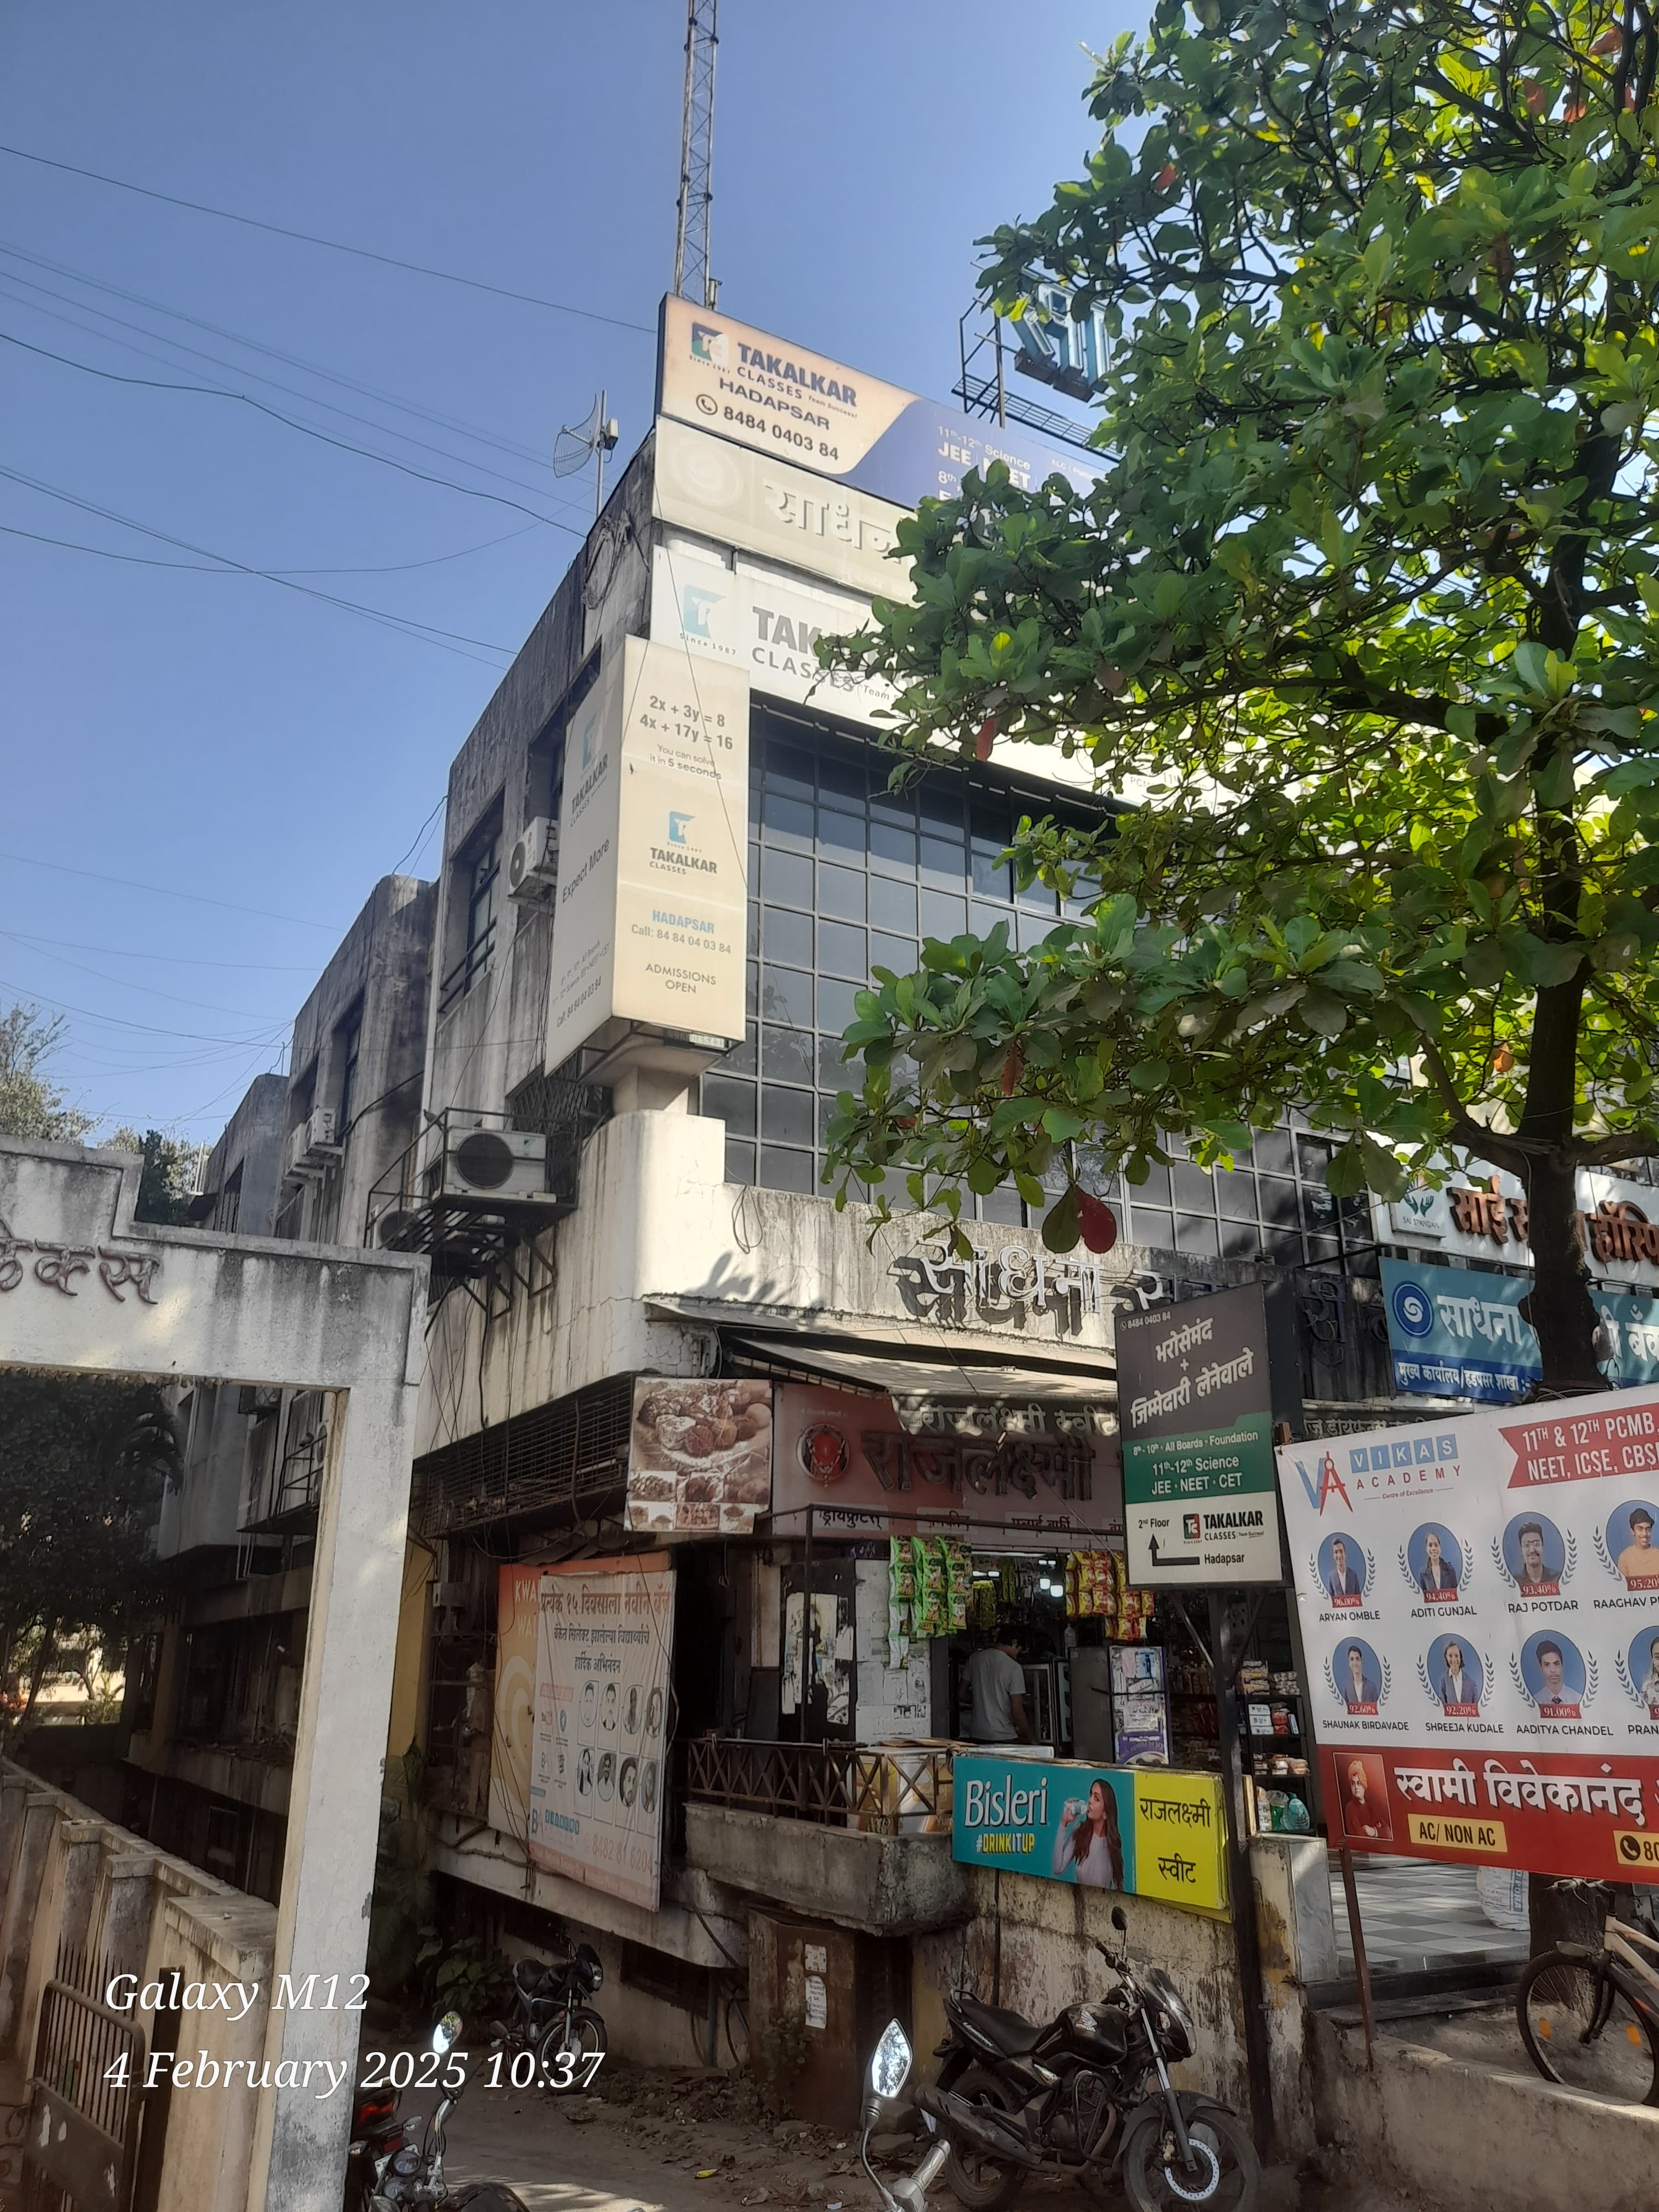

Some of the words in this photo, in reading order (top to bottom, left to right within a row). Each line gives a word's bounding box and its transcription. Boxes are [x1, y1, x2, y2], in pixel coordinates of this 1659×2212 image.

[737, 367, 802, 399] CLASSES
[738, 342, 857, 407] TAKALKAR
[720, 378, 830, 430] HADAPSAR
[724, 406, 766, 433] 8484
[772, 424, 813, 451] 0403
[818, 442, 839, 461] 84
[938, 442, 972, 466] JEE
[984, 444, 1031, 470] Science
[680, 633, 708, 648] Since
[712, 643, 737, 656] 1987
[863, 685, 890, 701] Team
[649, 695, 666, 712] 2x
[671, 706, 679, 714] +
[684, 705, 700, 722] 3y
[705, 714, 712, 722] =
[717, 714, 726, 728] 8
[640, 713, 657, 730] 4x
[661, 724, 670, 732] +
[675, 723, 700, 743] 17y
[703, 735, 712, 743] =
[716, 734, 733, 750] 16
[658, 743, 673, 757] You
[675, 750, 691, 761] can
[693, 753, 716, 767] solve
[650, 754, 656, 764] it
[658, 756, 666, 766] in
[667, 757, 675, 768] 5
[677, 761, 722, 781] seconds
[572, 753, 608, 815] TAKALKAR
[562, 869, 588, 904] Expect
[589, 838, 610, 871] More
[649, 860, 687, 875] CLASSES
[650, 847, 717, 874] TAKALKAR
[651, 909, 715, 935] HADAPSAR
[632, 924, 654, 938] Call:
[656, 928, 670, 940] 84
[672, 931, 686, 943] 84
[688, 935, 701, 947] 04
[703, 938, 716, 951] 03
[719, 942, 732, 955] 84
[645, 963, 717, 986] ADMISSIONS
[665, 979, 697, 994] OPEN
[1447, 1175, 1508, 1245] साई
[917, 1238, 1103, 1314] साधना
[1128, 1316, 1143, 1329] 8484
[1145, 1313, 1161, 1327] 0403
[1162, 1311, 1171, 1321] 84
[1437, 1295, 1523, 1346] साधना
[1155, 1316, 1214, 1364] भरोसेमंद
[1180, 1358, 1190, 1371] +
[1130, 1375, 1191, 1428] जिम्मेदारी
[1195, 1347, 1254, 1398] लेनेवाले
[1397, 1361, 1421, 1386] मुख्य
[1494, 1374, 1520, 1392] शाखा
[1165, 1441, 1175, 1452] All
[1176, 1438, 1203, 1450] Boards
[1209, 1431, 1259, 1447] Foundation
[1521, 1427, 1549, 1452] 11TH
[1553, 1425, 1567, 1448] &
[1569, 1417, 1600, 1445] 12TH
[1353, 1439, 1454, 1469] VIKAS
[1527, 1454, 1571, 1481] NEET,
[1574, 1448, 1619, 1475] ICSE,
[1152, 1458, 1193, 1476] 11th-12th
[1195, 1456, 1239, 1473] Science
[1356, 1464, 1462, 1491] ACADEMY
[1151, 1480, 1172, 1495] JEE
[1180, 1475, 1210, 1493] NEET
[1218, 1472, 1243, 1488] CET
[1381, 1491, 1399, 1500] Centre
[1405, 1486, 1434, 1498] Excellence
[1138, 1518, 1149, 1528] 2nd
[1150, 1517, 1170, 1528] Floor
[1203, 1510, 1264, 1530] TAKALKAR
[1204, 1531, 1237, 1541] CLASSES
[1204, 1552, 1245, 1567] Hadapsar
[541, 1583, 564, 1613] प्रत्येक
[581, 1583, 622, 1615] दिवसाला
[624, 1580, 651, 1615] नवीन
[1426, 1591, 1455, 1601] 94.40%
[1522, 1584, 1557, 1595] 93.40%
[1333, 1597, 1360, 1606] 96.00%
[1411, 1607, 1436, 1618] ADITI
[1437, 1605, 1478, 1616] GUNJAL
[1508, 1603, 1528, 1614] RAJ
[1532, 1600, 1579, 1613] POTDAR
[1594, 1597, 1647, 1611] RAAGHAV
[1319, 1611, 1348, 1623] ARYAN
[1349, 1610, 1381, 1621] OMBLE
[568, 1623, 589, 1642] सिलेक्ट
[591, 1623, 616, 1646] झालेल्या
[575, 1651, 592, 1671] हार्दिक
[593, 1652, 620, 1674] अभिनंदन
[1348, 1703, 1376, 1715] 92.60%
[1446, 1705, 1477, 1716] 92.20%
[1543, 1705, 1577, 1717] 91.00%
[1322, 1719, 1360, 1730] SHAUNAK
[1361, 1720, 1410, 1731] BIRDAVADE
[1425, 1721, 1466, 1733] SHREEJA
[1467, 1722, 1505, 1734] KUDALE
[1516, 1724, 1560, 1736] AADITYA
[1562, 1724, 1614, 1736] CHANDEL
[964, 1773, 1048, 1828] Bisleri
[1394, 1757, 1478, 1806] स्वामी
[1482, 1757, 1646, 1828] विवेकानंद
[1139, 1797, 1211, 1829] राजलक्ष्मी
[975, 1832, 1035, 1854] #DRINKITUP
[1419, 1822, 1440, 1841] AC/
[1444, 1824, 1473, 1844] NON
[1478, 1827, 1496, 1846] AC
[1157, 1851, 1196, 1885] स्वीट
